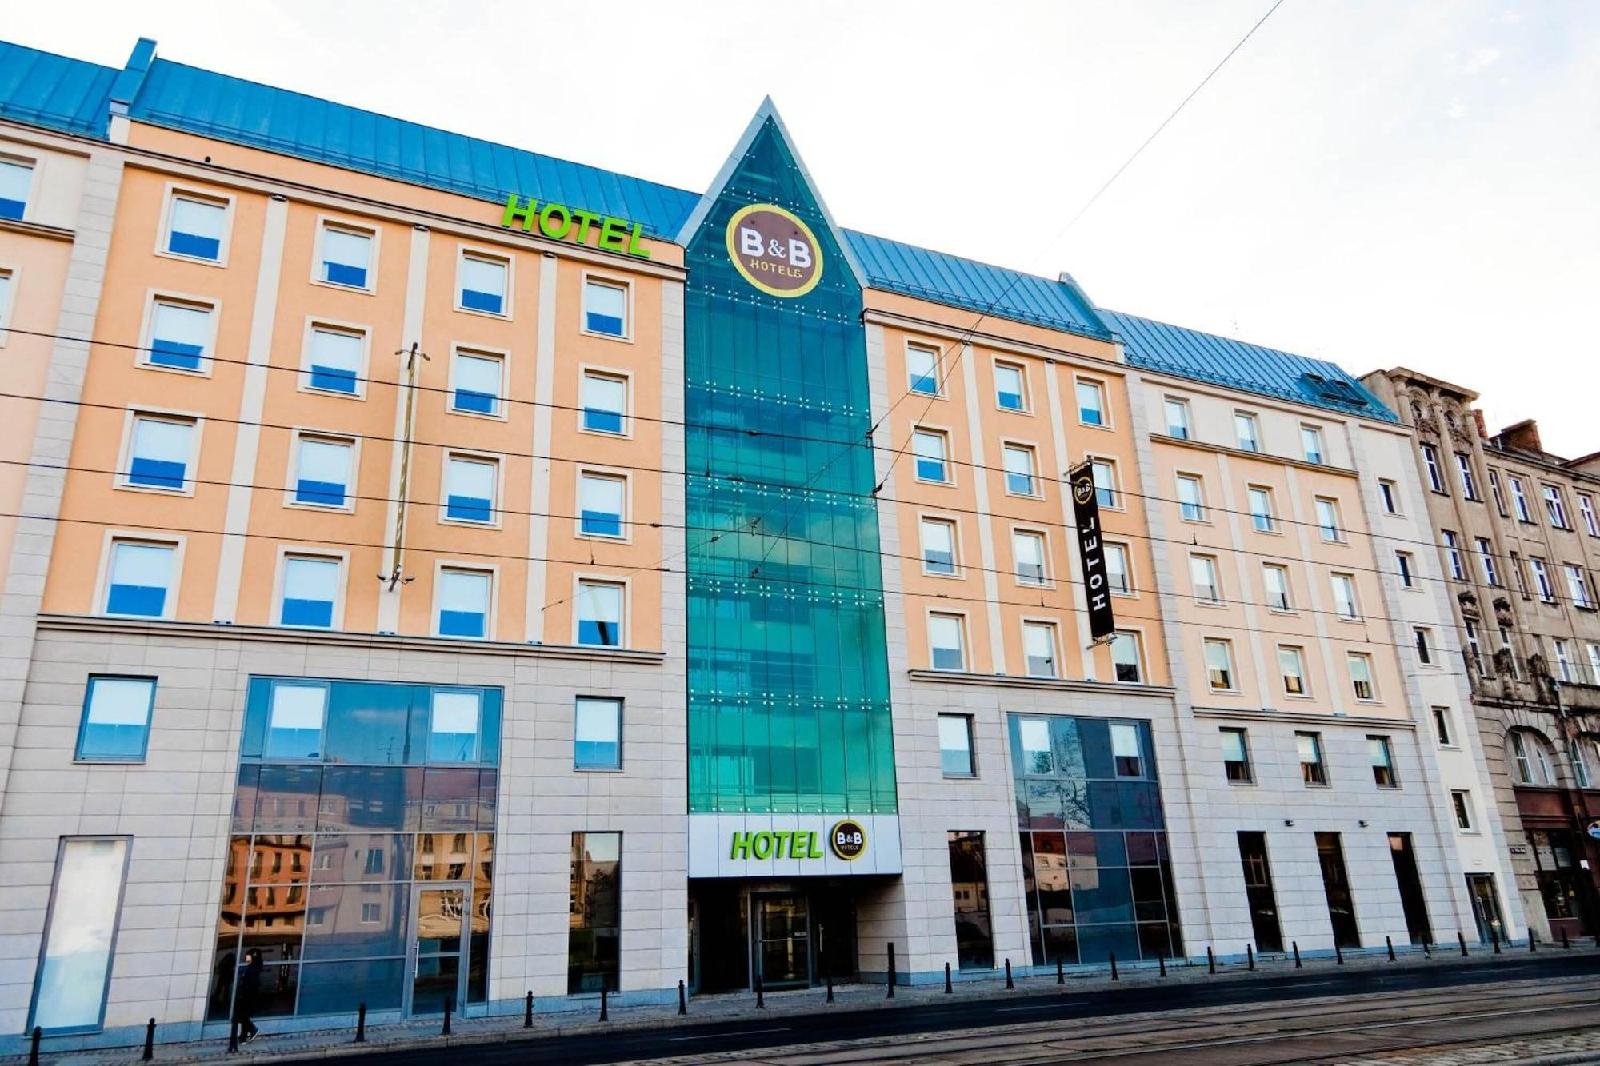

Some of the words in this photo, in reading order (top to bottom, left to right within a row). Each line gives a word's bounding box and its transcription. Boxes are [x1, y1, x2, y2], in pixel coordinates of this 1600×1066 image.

[503, 193, 651, 259] HOTEL
[750, 259, 803, 278] HOTELS
[1082, 516, 1106, 611] HOTEL
[731, 831, 824, 860] HOTEL
